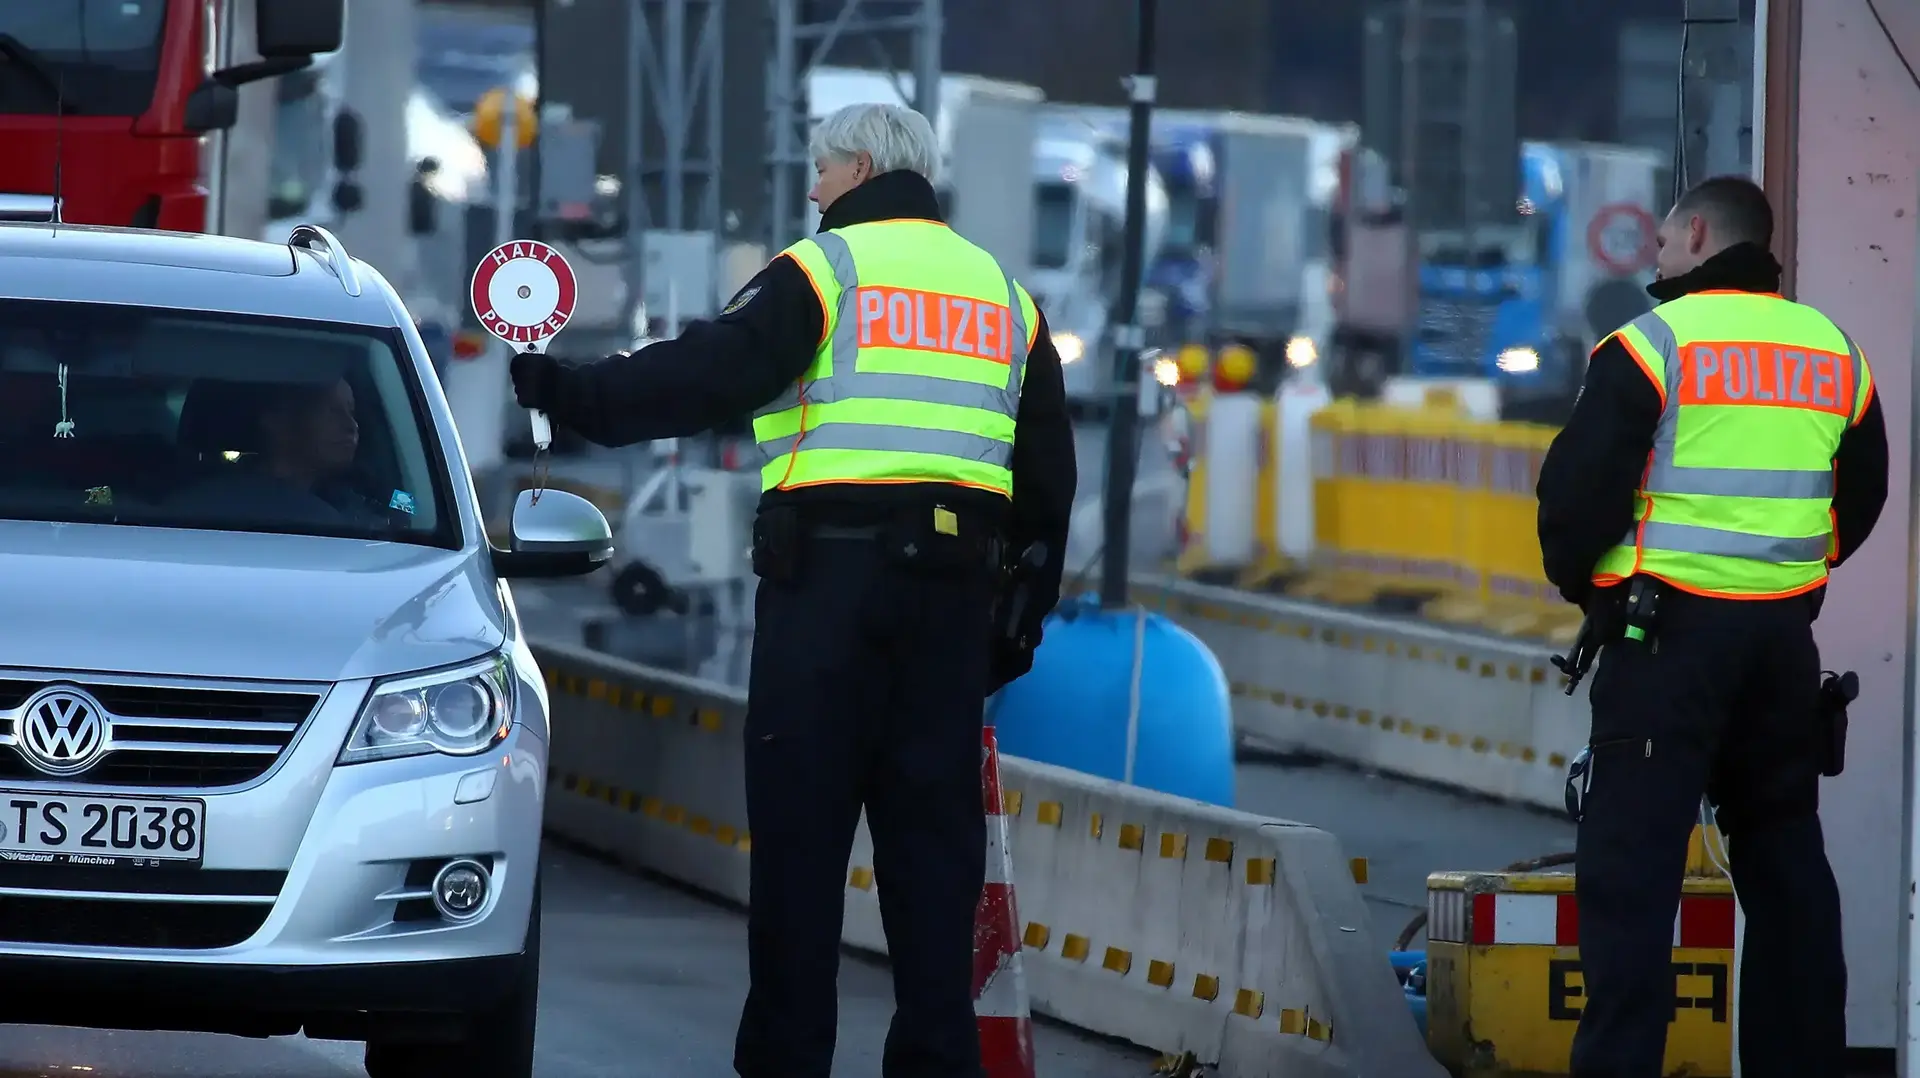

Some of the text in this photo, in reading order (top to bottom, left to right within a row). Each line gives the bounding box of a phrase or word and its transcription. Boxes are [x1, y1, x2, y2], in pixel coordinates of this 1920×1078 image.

[492, 243, 556, 266] HALT
[482, 308, 568, 342] POLIZEI
[860, 290, 1008, 359] POLIZEI
[1695, 346, 1842, 408] POLIZEI
[10, 799, 196, 851] TS 2038
[8, 851, 116, 866] Westend München
